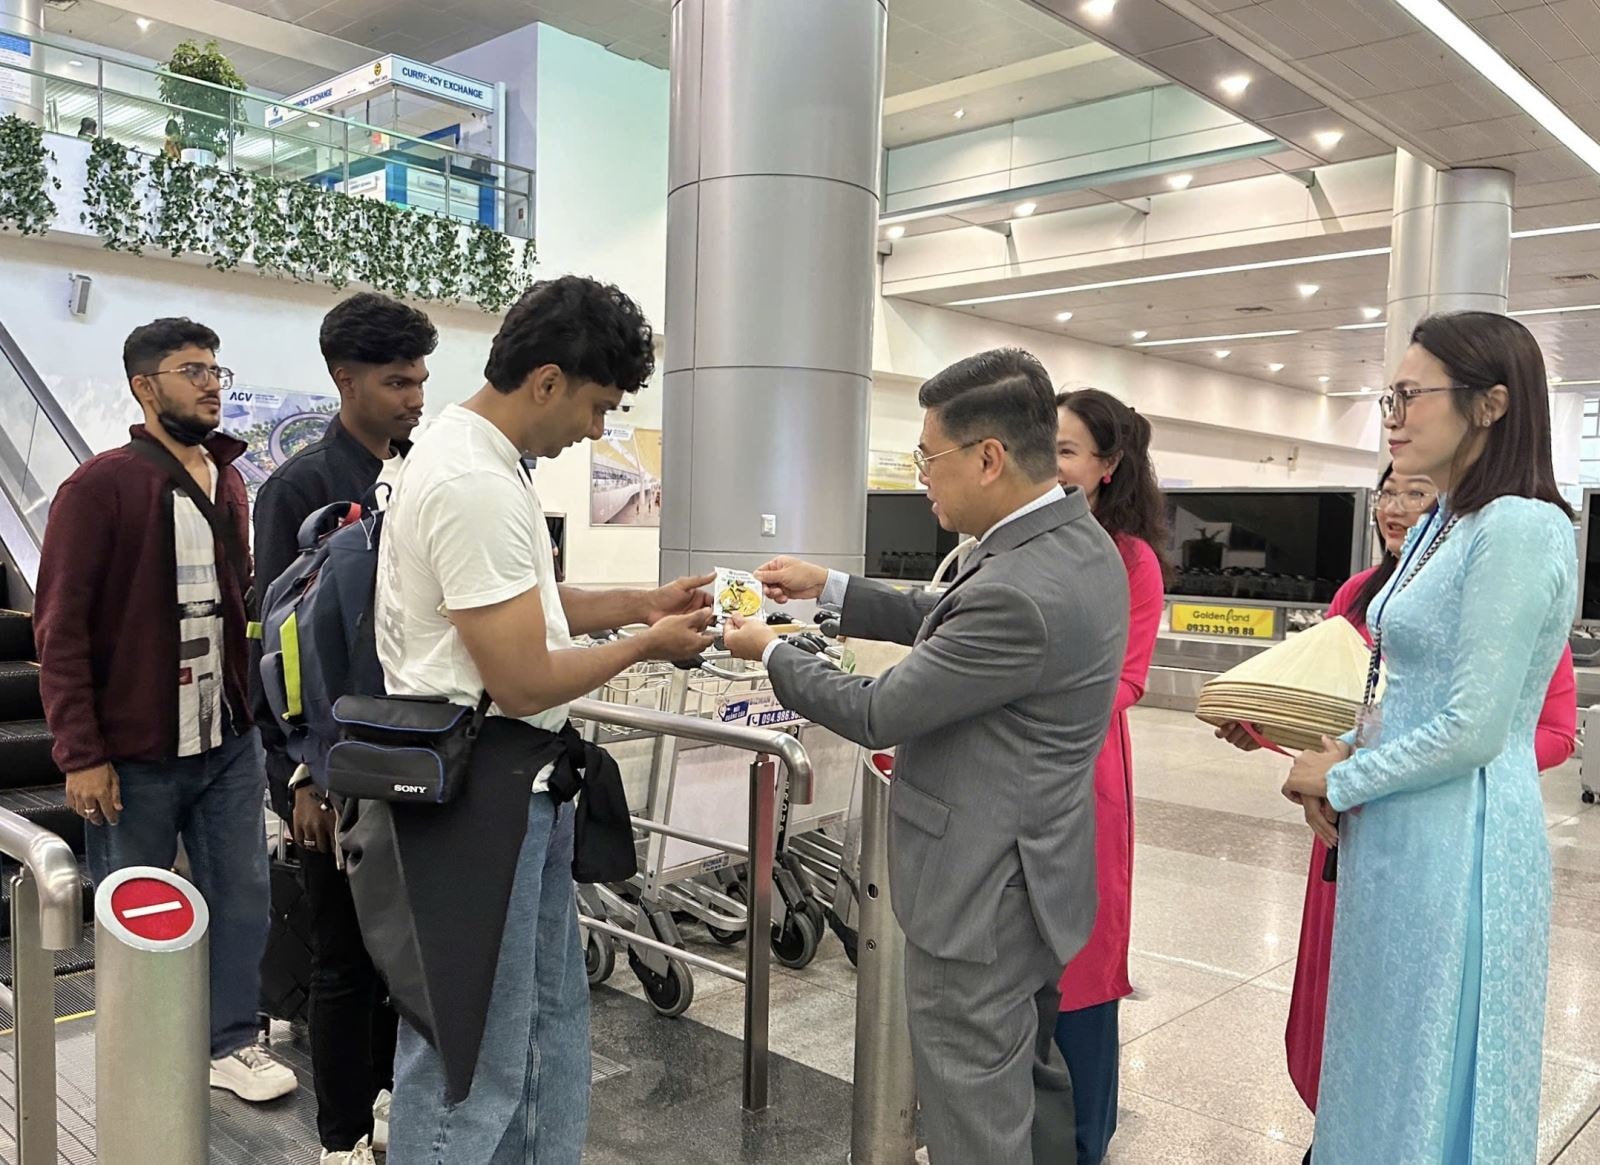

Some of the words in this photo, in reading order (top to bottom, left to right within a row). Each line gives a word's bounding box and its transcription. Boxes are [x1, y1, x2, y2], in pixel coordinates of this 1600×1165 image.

[402, 67, 442, 86] CURRENCY
[443, 80, 484, 99] EXCHANGE
[230, 391, 253, 402] ACV
[1186, 623, 1210, 633] 0933
[1212, 625, 1225, 634] 33
[1227, 626, 1239, 635] 99
[1242, 627, 1255, 636] 88
[394, 784, 427, 793] SONY
